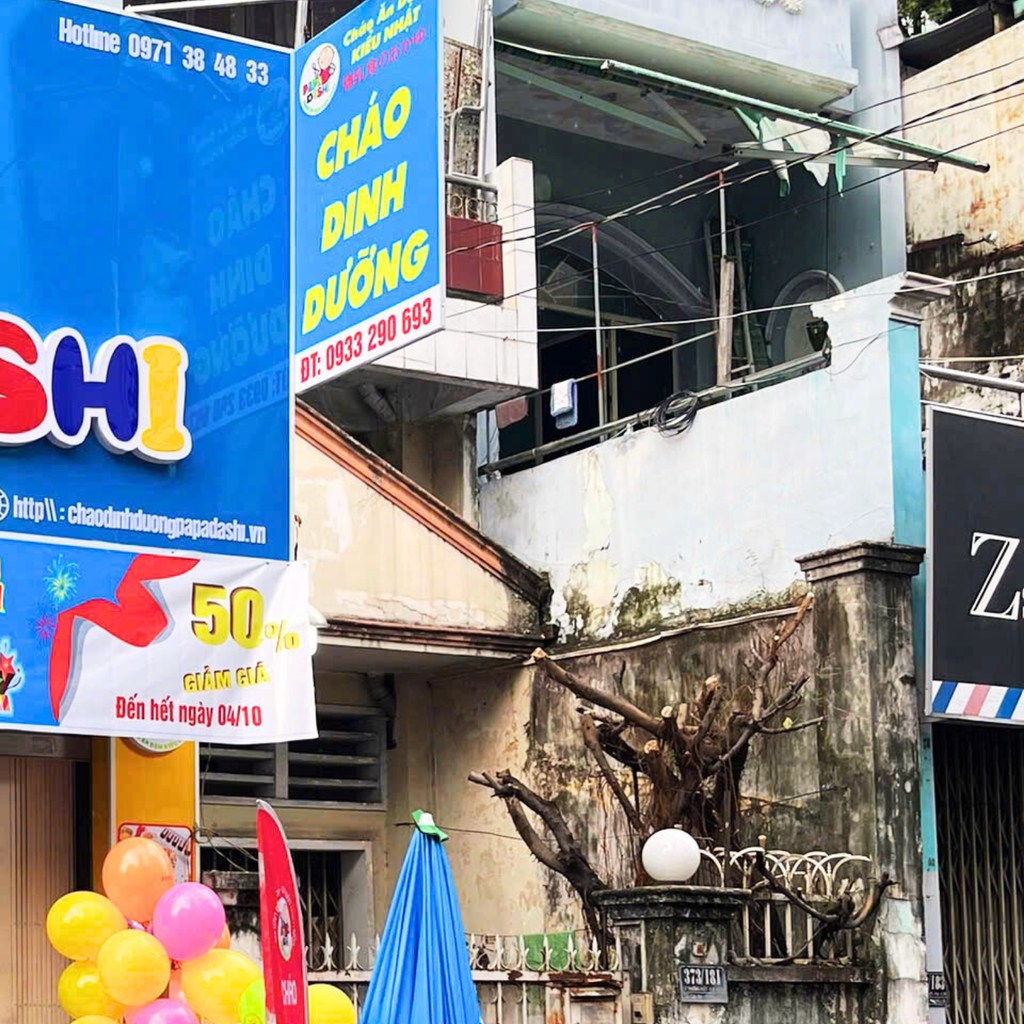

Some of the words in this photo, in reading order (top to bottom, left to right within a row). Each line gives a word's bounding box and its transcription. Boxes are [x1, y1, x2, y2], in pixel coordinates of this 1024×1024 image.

[59, 17, 121, 53] Hotline
[128, 33, 172, 65] 0971
[182, 46, 206, 73] 38
[214, 54, 238, 79] 48
[246, 60, 270, 86] 33
[343, 18, 374, 47] Cháo
[316, 86, 412, 180] CHÁO
[320, 161, 408, 253] DINH
[302, 228, 430, 335] DƯỠNG
[300, 353, 322, 385] ĐT:
[326, 335, 363, 370] 0933
[368, 314, 397, 353] 290
[401, 297, 433, 337] 693
[68, 502, 266, 545] chaodinhduongpapadashi.vn
[969, 531, 1024, 620] Z
[116, 692, 145, 721] Đến
[150, 695, 175, 722] hết
[179, 701, 214, 728] ngày
[218, 705, 262, 728] 04/10
[183, 664, 231, 694] GIẢM
[235, 660, 271, 688] GIÁ
[683, 968, 721, 986] 373/181
